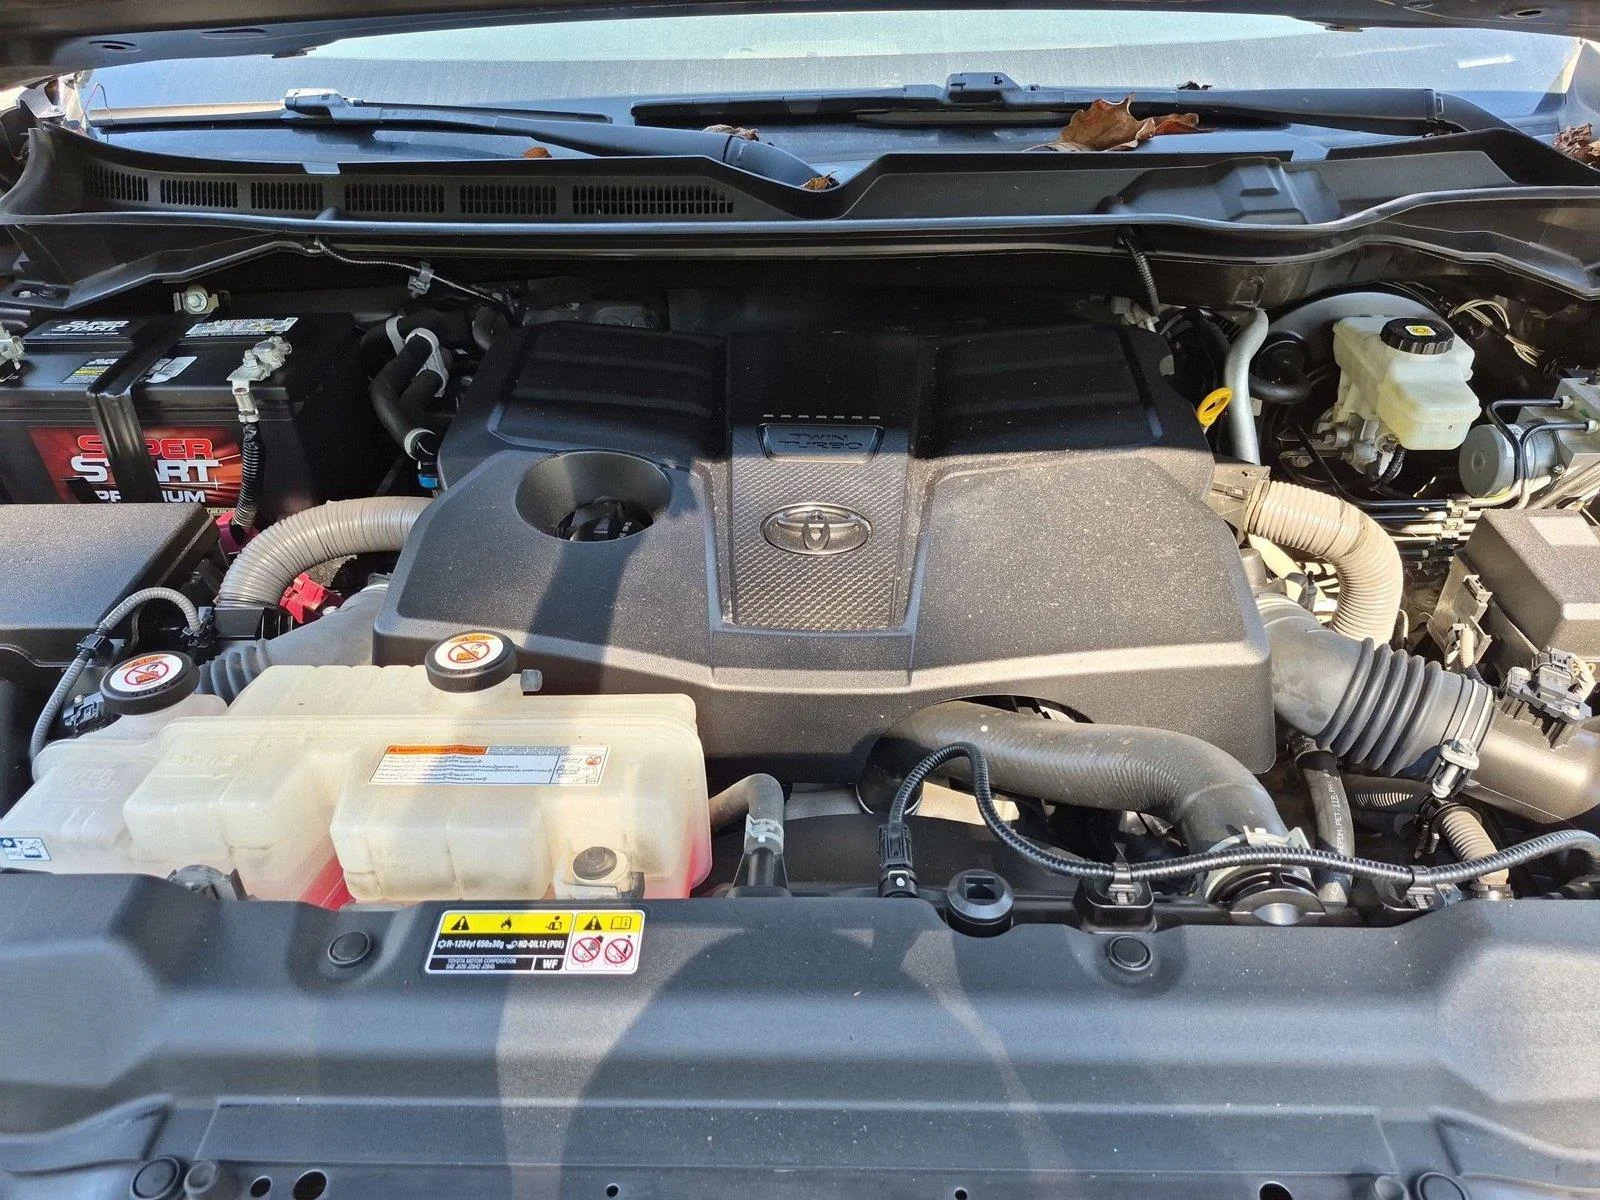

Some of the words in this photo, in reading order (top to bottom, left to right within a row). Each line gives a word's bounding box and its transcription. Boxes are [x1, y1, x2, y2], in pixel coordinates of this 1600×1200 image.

[788, 433, 848, 441] TWIN
[77, 434, 213, 459] SPER
[778, 440, 863, 450] TURBO
[71, 455, 220, 482] SRT
[542, 959, 559, 969] WF
